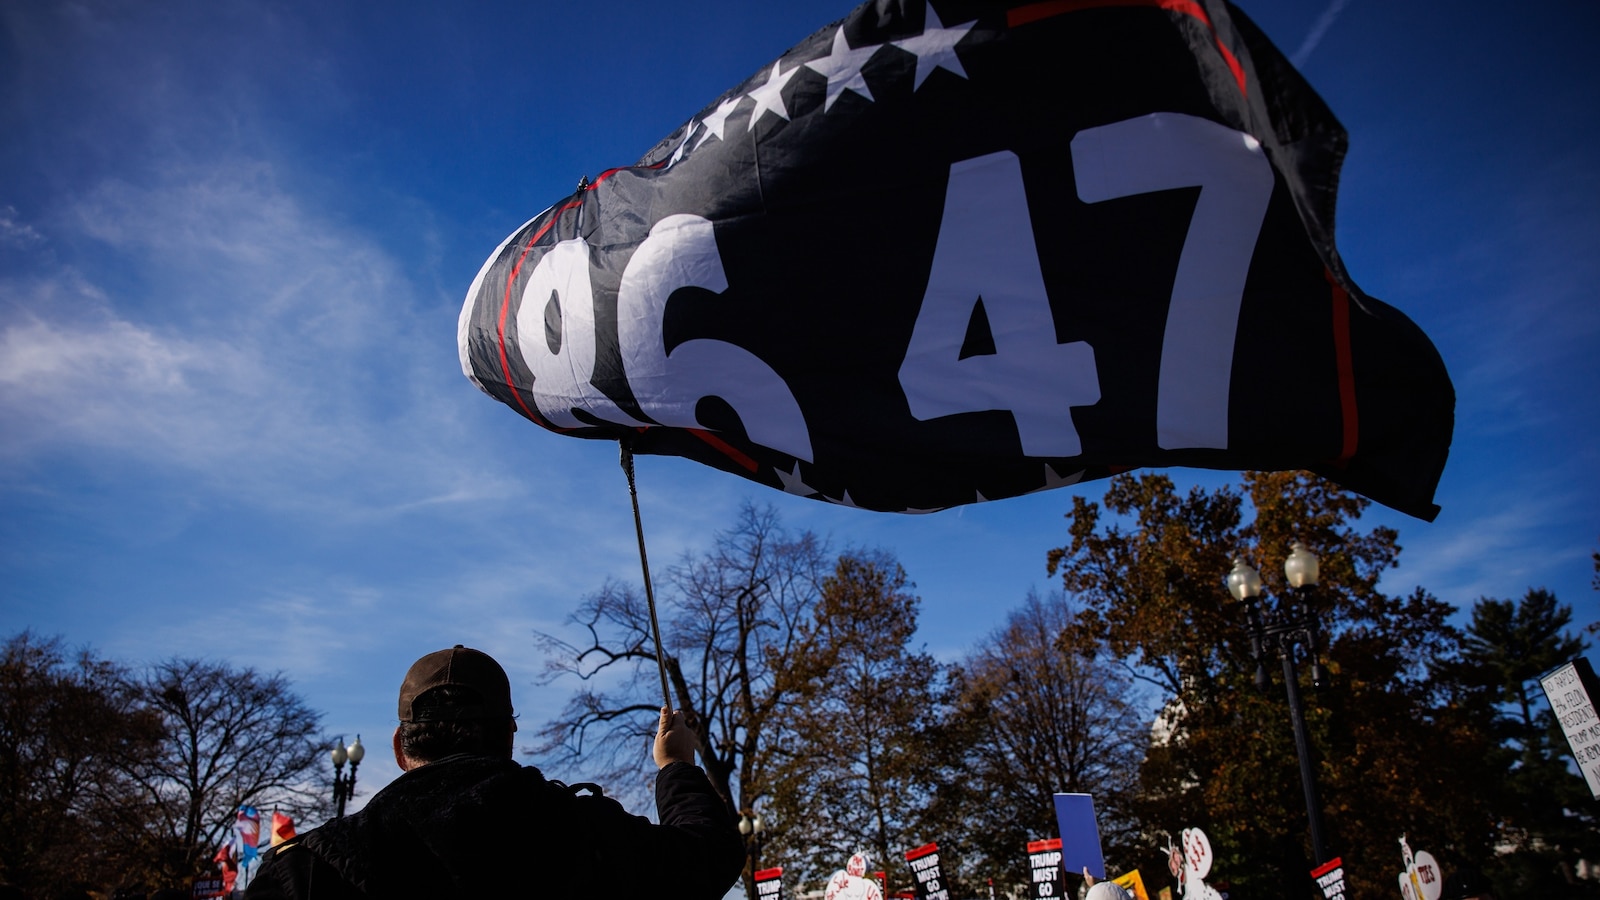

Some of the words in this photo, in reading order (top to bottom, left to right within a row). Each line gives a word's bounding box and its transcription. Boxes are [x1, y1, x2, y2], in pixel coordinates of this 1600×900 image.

[897, 112, 1275, 458] 47
[1564, 688, 1586, 709] FELON
[1568, 729, 1588, 746] TRUMP
[1575, 750, 1588, 765] BE
[910, 854, 939, 873] TRUMP
[1029, 852, 1062, 868] TRUMP
[917, 866, 941, 884] MUST
[1033, 867, 1058, 883] MUST
[1315, 867, 1344, 889] TRUMP
[756, 879, 781, 896] TRUMP
[926, 879, 940, 893] GO
[1038, 882, 1053, 897] GO
[1323, 879, 1346, 899] MUST
